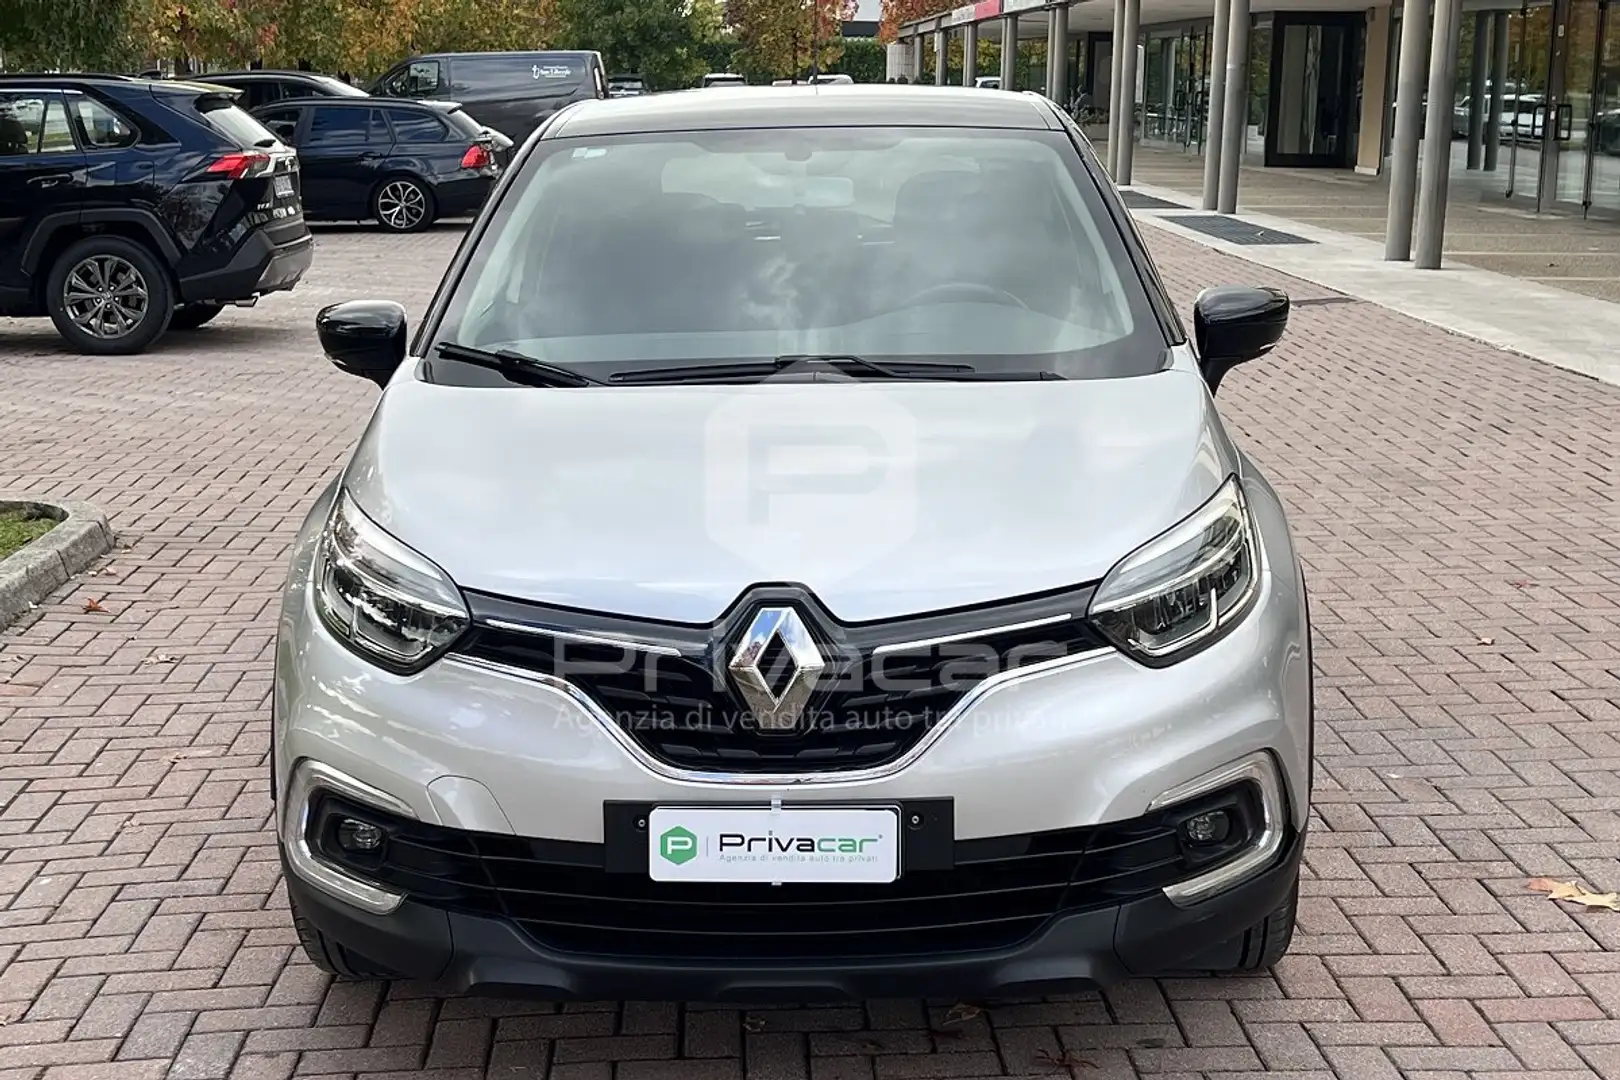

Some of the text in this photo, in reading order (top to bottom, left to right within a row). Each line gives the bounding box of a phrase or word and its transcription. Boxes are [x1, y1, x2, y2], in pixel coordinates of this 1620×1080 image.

[667, 836, 693, 855] P
[719, 830, 878, 853] Privacar
[719, 854, 756, 863] Agenzia
[772, 854, 805, 862] vendita
[848, 854, 878, 864] privati
